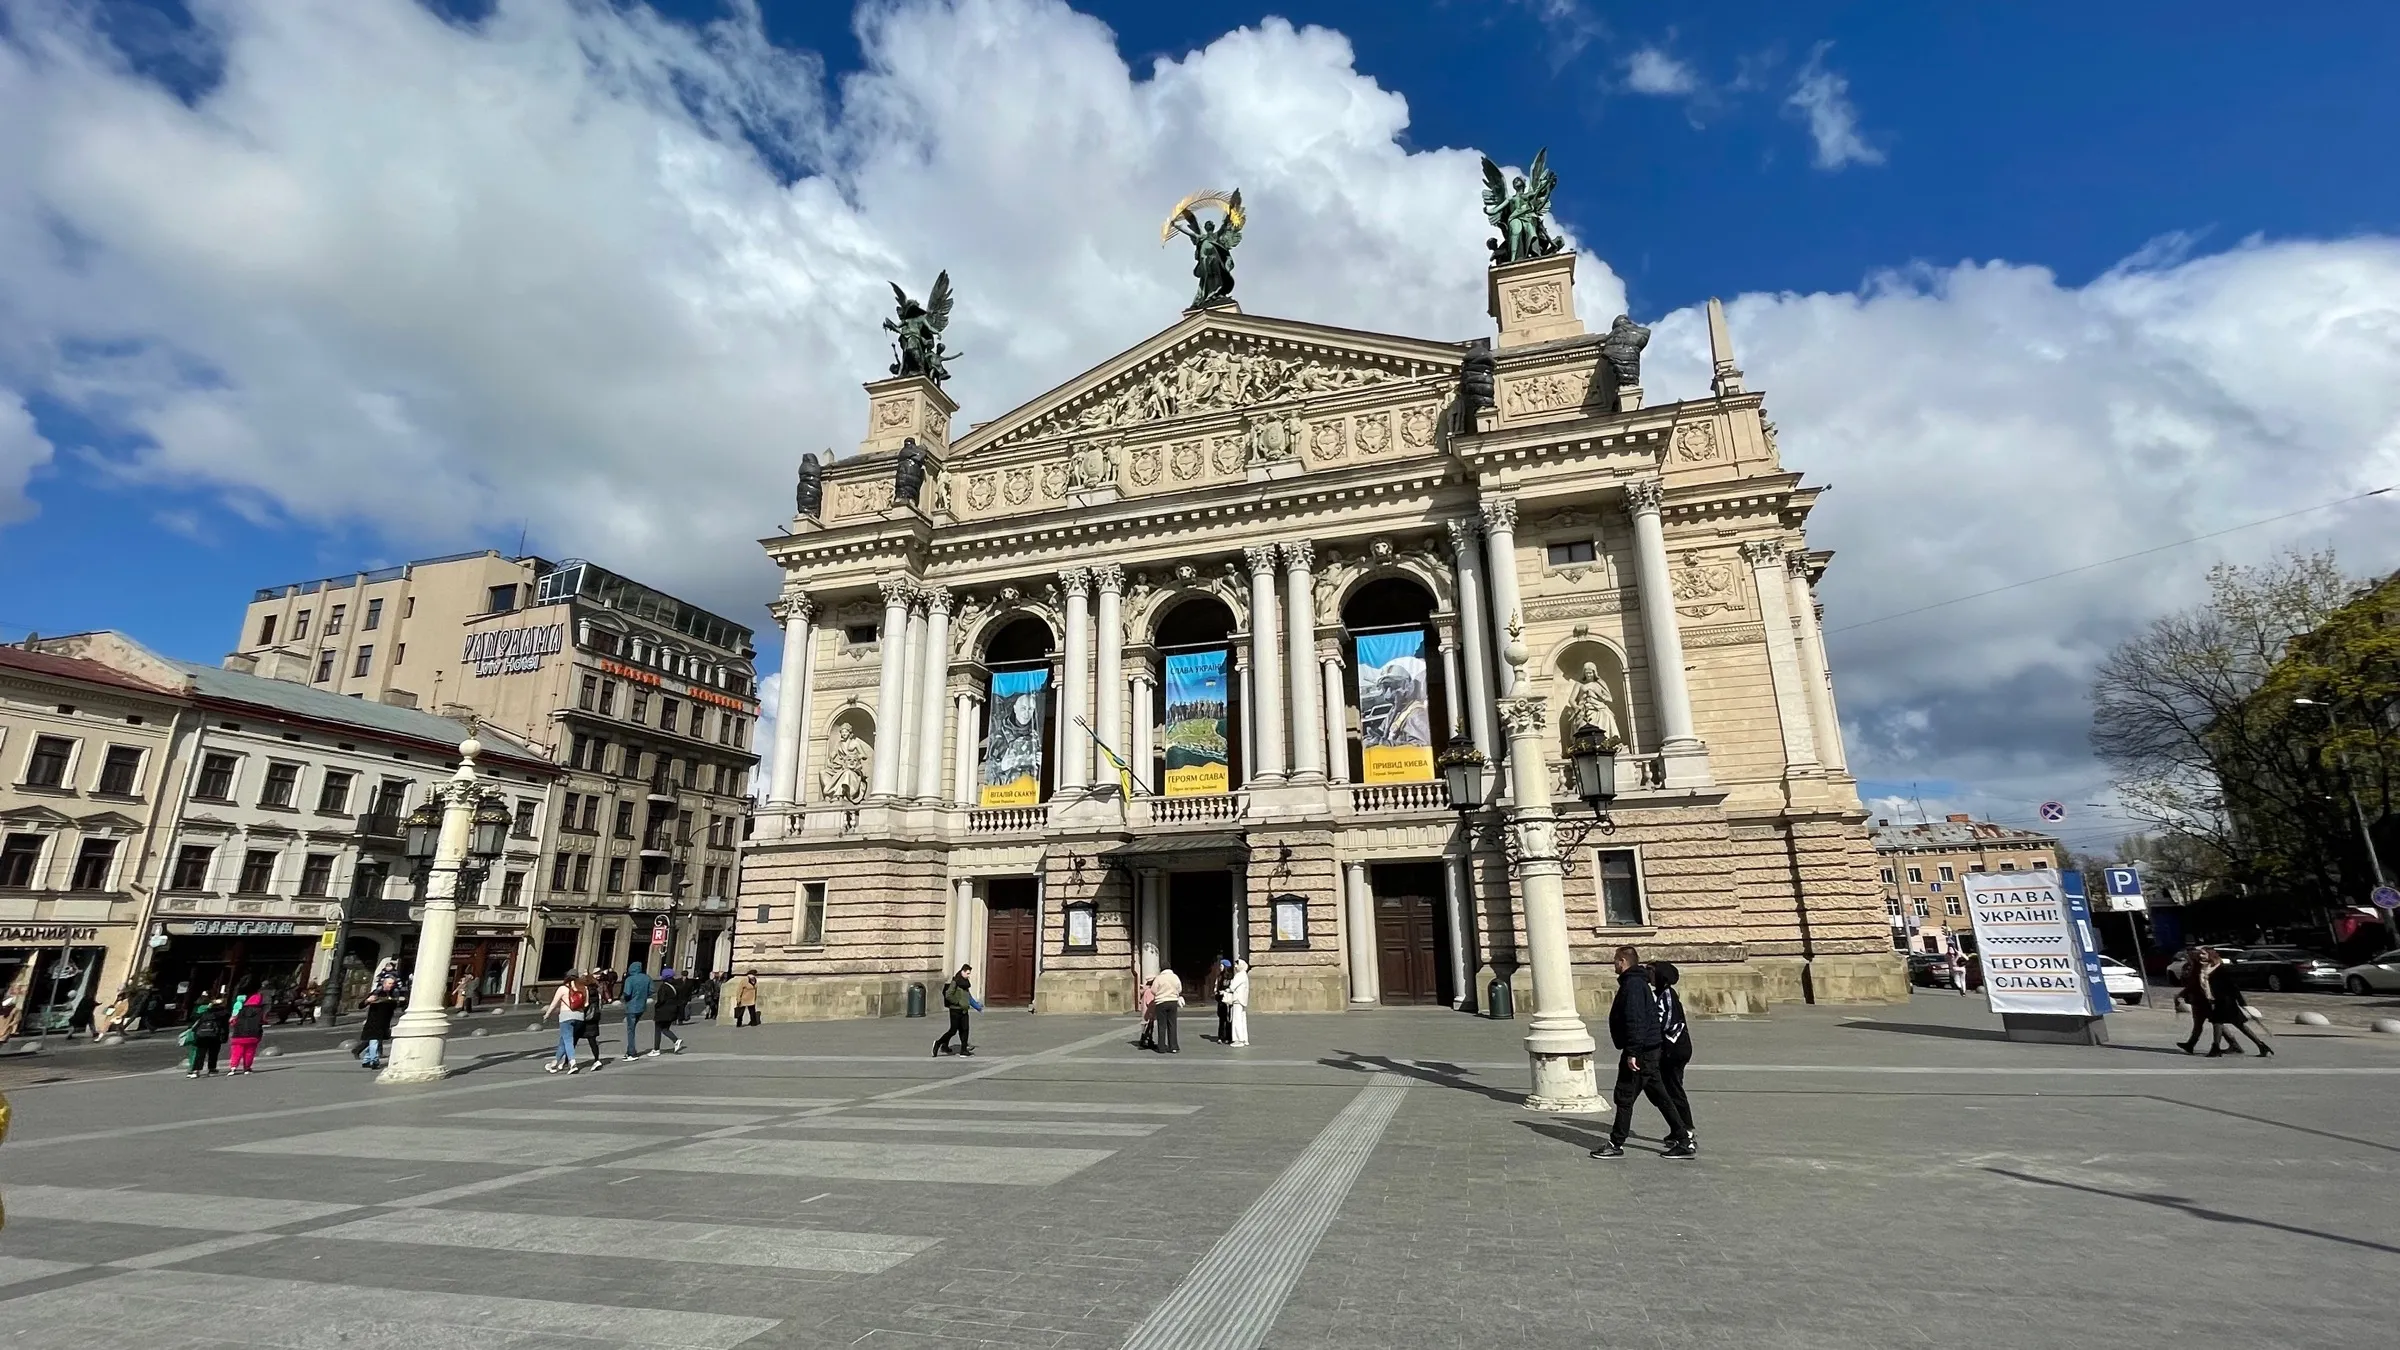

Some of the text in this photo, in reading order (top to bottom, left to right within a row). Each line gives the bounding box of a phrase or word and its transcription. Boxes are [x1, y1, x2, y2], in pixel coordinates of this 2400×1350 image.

[461, 623, 564, 663] PANORAMA
[475, 655, 541, 677] Lviv Hotel
[1170, 666, 1194, 675] СЛАВА
[1373, 761, 1403, 769] ПРИВИД
[1168, 772, 1226, 783] ГЕРОЯМ СЛАВА!
[2114, 871, 2132, 893] P
[1976, 891, 2055, 904] СЛАВА
[1980, 907, 2059, 922] УКРАЇНІ!
[1991, 958, 2070, 969] ГЕРОЯМ
[1996, 977, 2075, 988] СЛАВА!
